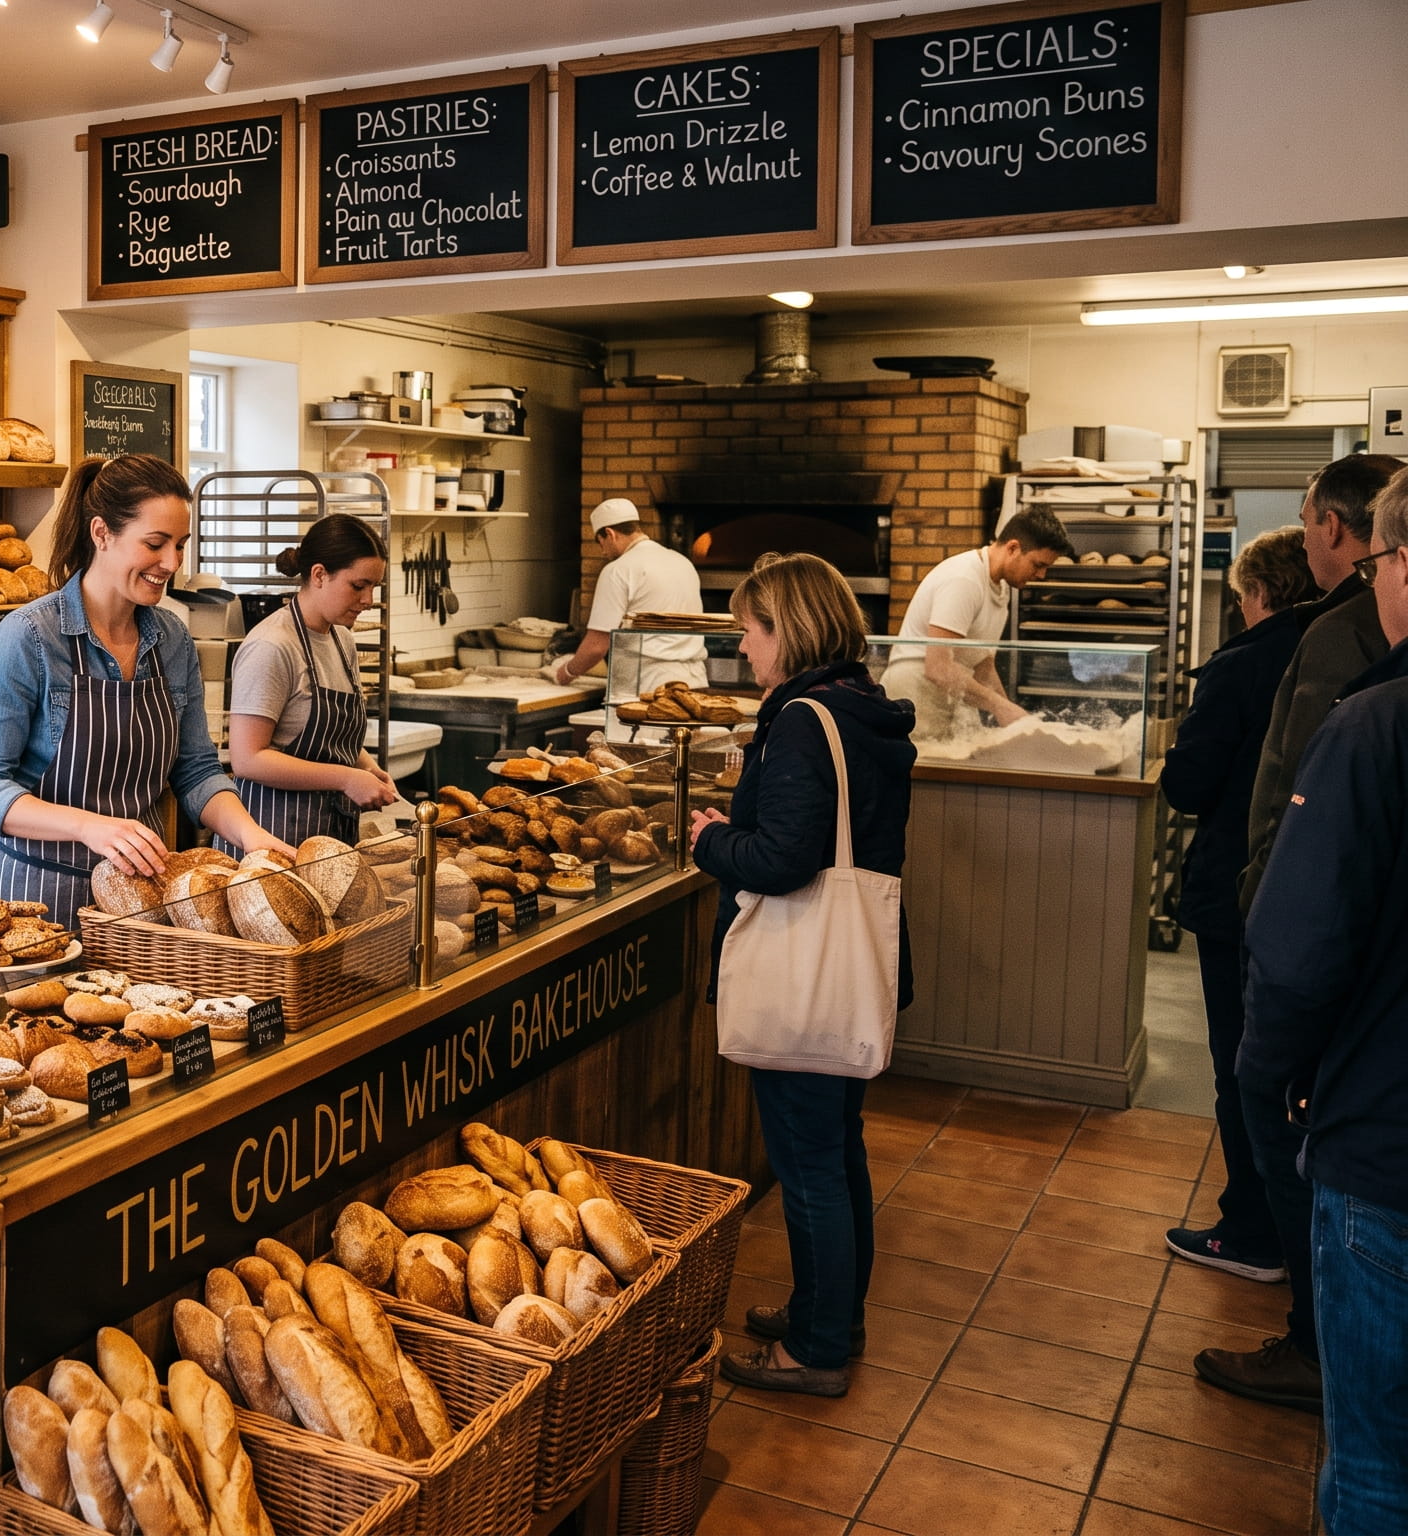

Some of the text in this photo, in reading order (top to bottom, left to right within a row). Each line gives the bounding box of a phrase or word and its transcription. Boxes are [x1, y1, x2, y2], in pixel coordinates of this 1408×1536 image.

[920, 19, 1130, 79] SPECIALS:
[633, 65, 762, 110] CAKES:
[898, 80, 1146, 132] Cinnamon Buns
[356, 97, 497, 141] PASTRIES:
[591, 111, 790, 159] Lemon Drizzle
[113, 125, 279, 172] FRESH BREAD:
[335, 142, 457, 178] Croissants
[899, 127, 1148, 177] Savoury Scones
[128, 169, 243, 207] Sourdough
[335, 173, 423, 207] Almond
[591, 147, 803, 197] Coffee & Walnut
[128, 211, 171, 242] Rye
[335, 190, 523, 235] Pain au Chocolat
[129, 233, 232, 274] Baguette
[335, 230, 459, 263] Fruit Tarts
[106, 934, 649, 1287] THE GOLDEN WHISK BAKEHOUSE
